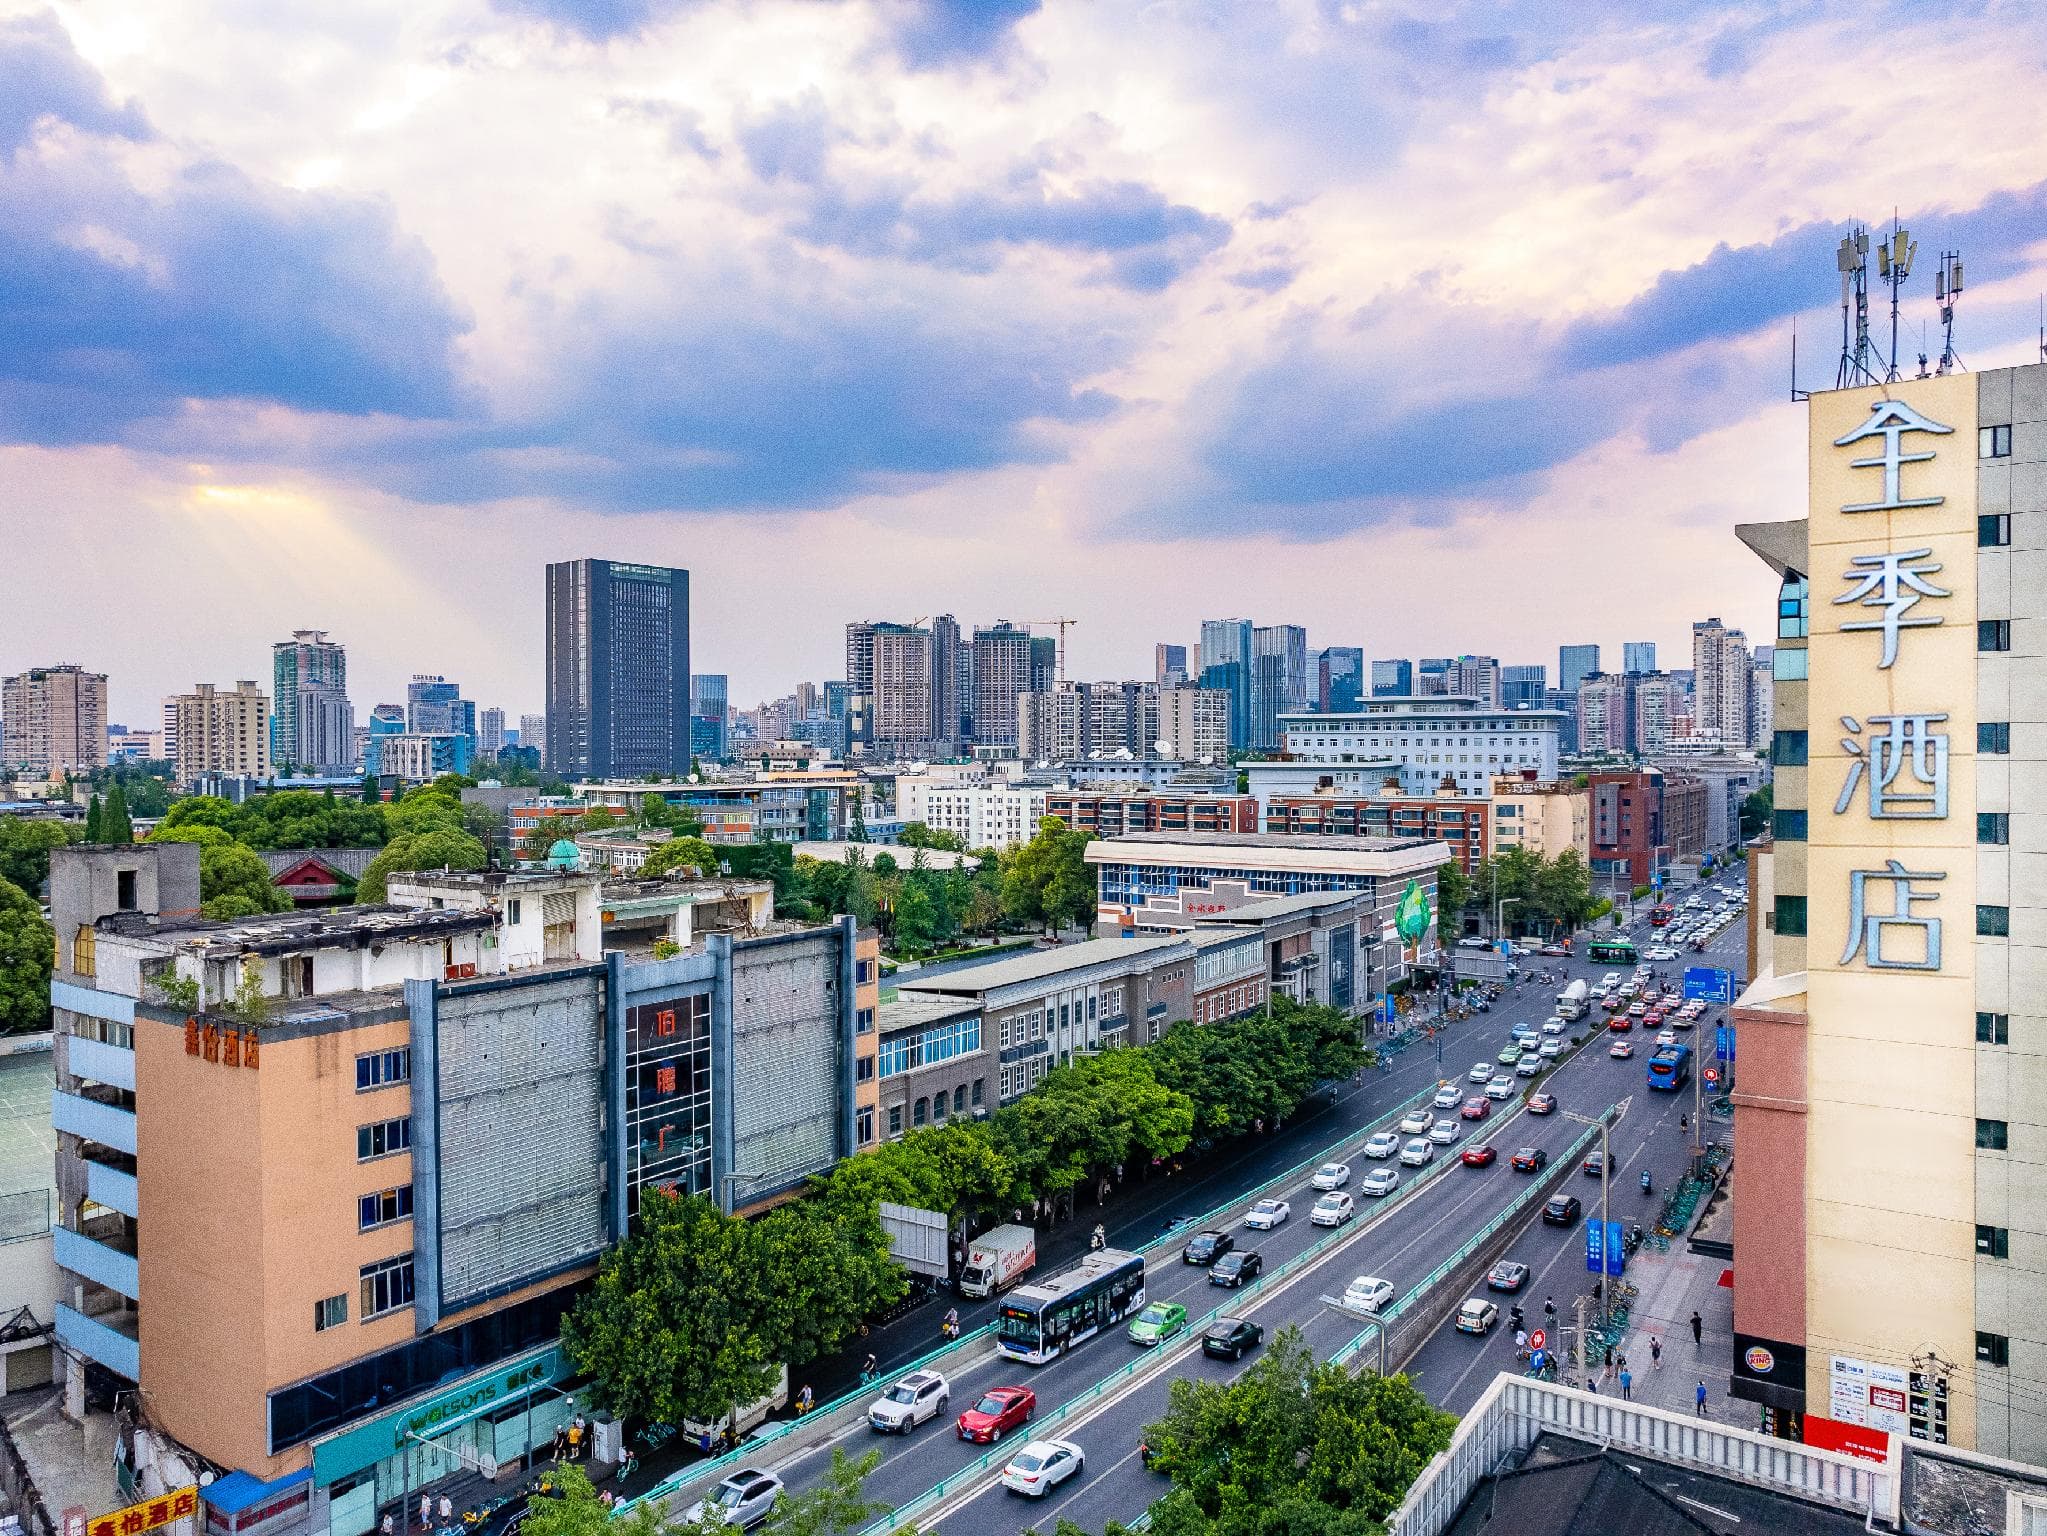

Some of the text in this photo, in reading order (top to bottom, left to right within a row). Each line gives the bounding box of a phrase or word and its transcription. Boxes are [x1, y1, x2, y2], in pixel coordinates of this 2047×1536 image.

[1833, 400, 1954, 970] 全季酒店
[409, 1383, 497, 1430] watsons
